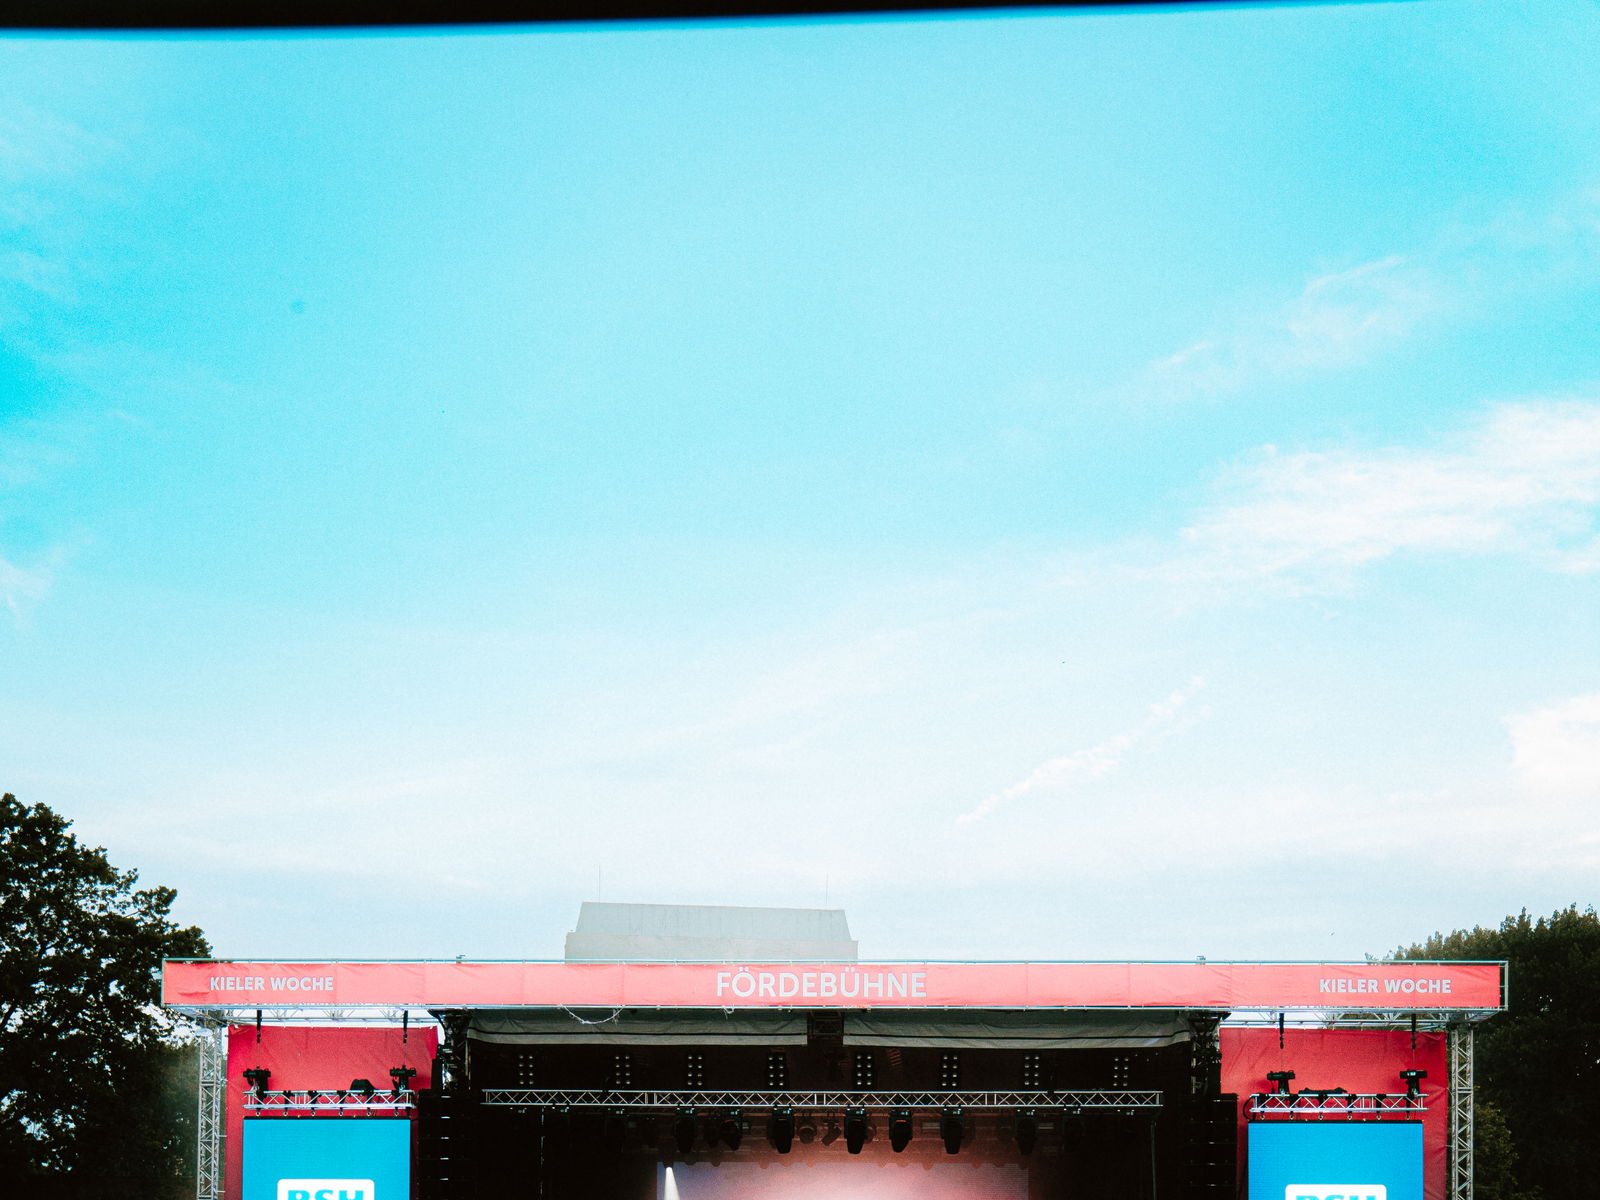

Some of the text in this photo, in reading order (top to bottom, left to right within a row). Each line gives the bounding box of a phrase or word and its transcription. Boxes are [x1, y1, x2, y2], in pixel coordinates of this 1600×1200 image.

[210, 976, 334, 991] KIELER WOCHE
[717, 966, 927, 997] FÖRDEBÜHNE
[1319, 979, 1451, 993] KIELER WOCHE
